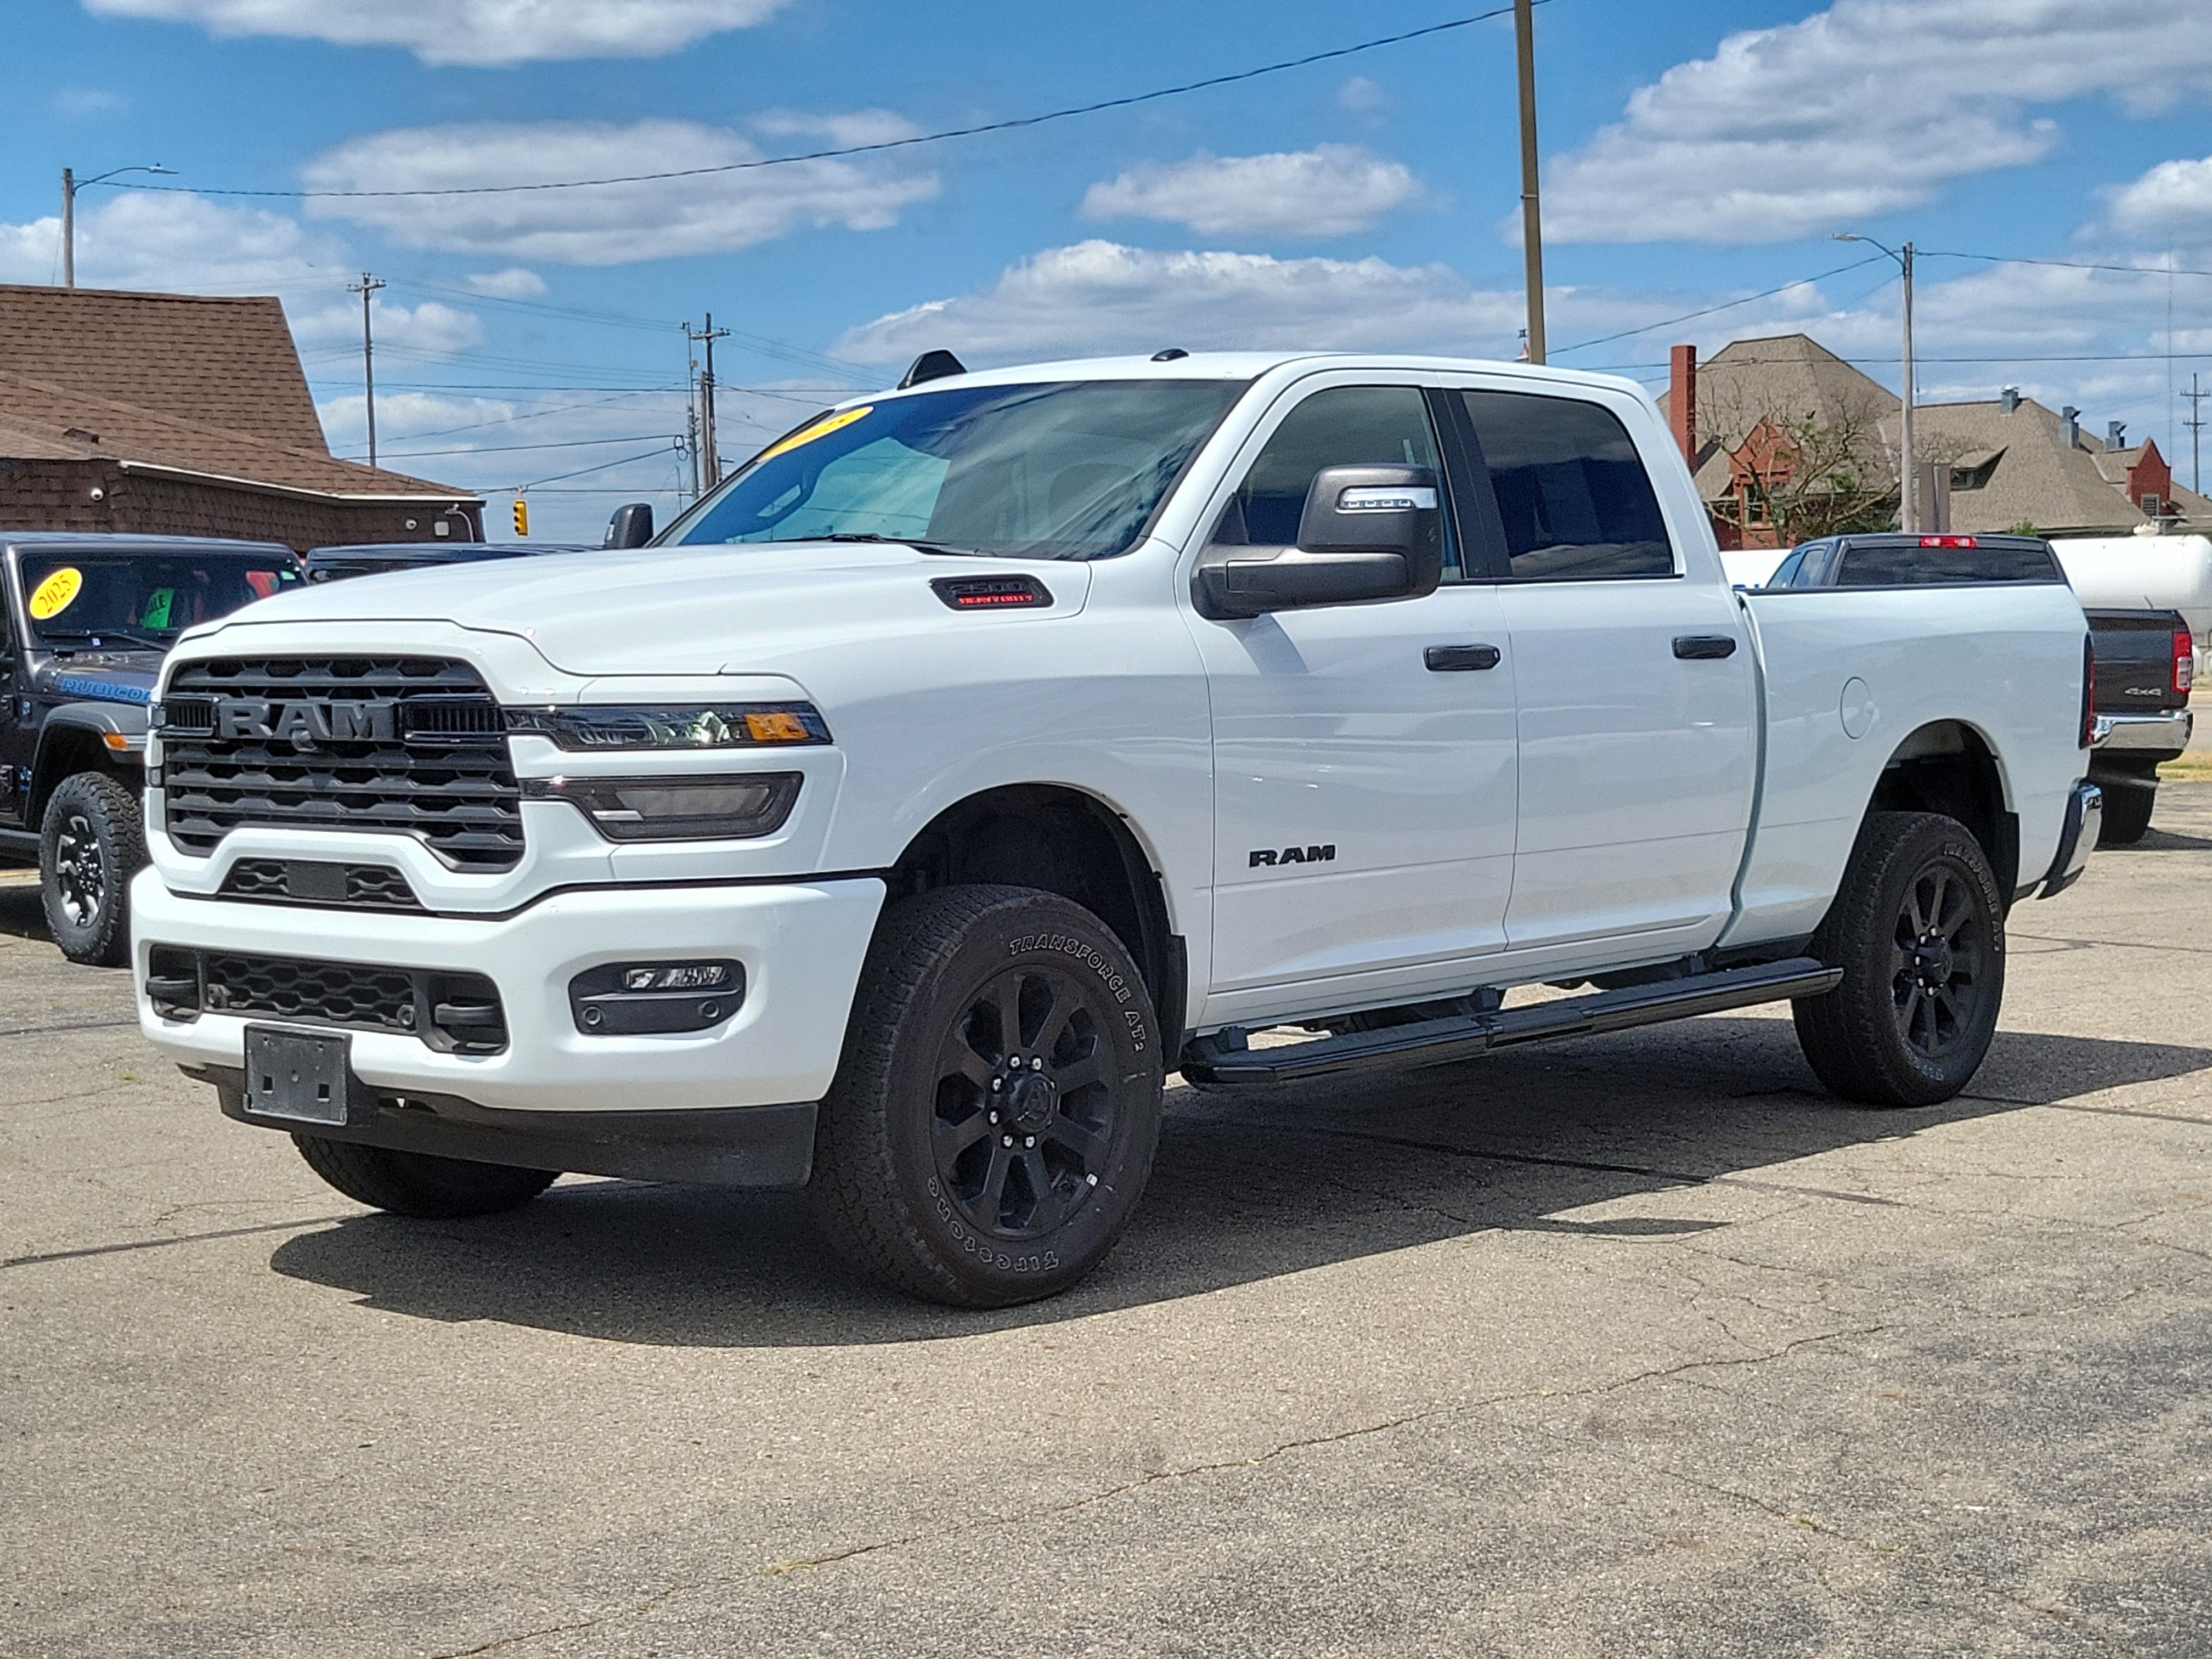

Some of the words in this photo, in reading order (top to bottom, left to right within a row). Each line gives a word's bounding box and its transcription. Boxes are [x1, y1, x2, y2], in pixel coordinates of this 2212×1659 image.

[39, 574, 71, 614] 2025
[220, 703, 395, 741] RAM
[1249, 844, 1336, 868] RAM
[1009, 934, 1131, 1003] TRANSFORCE
[1125, 1011, 1146, 1052] AT2
[928, 1176, 1059, 1272] Firestone
